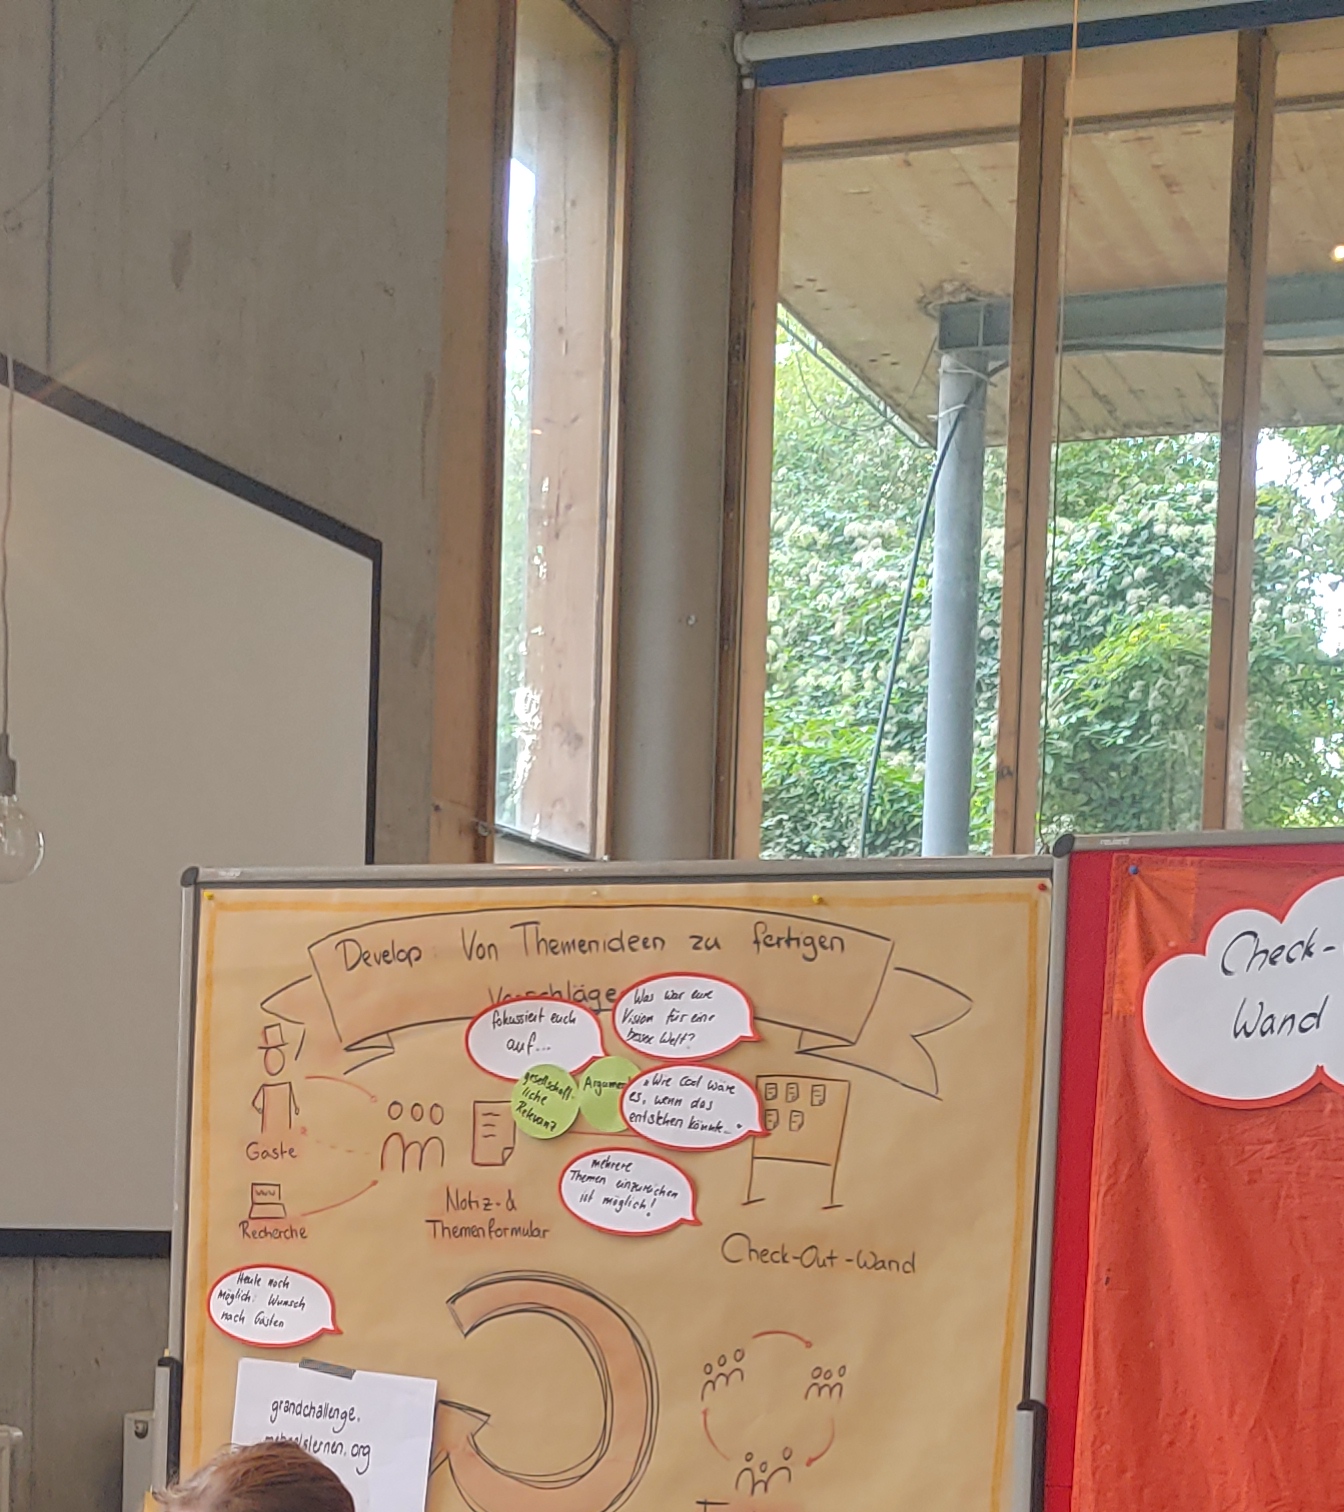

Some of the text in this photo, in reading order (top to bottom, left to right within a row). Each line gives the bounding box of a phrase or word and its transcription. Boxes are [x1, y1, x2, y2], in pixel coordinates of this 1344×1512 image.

[460, 927, 499, 962] Von
[510, 920, 666, 958] Themenideen
[689, 931, 722, 953] zu
[752, 920, 846, 962] fertigen
[634, 988, 654, 1005] Was
[549, 1010, 578, 1026] euch
[621, 1007, 654, 1025] Vision
[1232, 995, 1330, 1039] Wand
[659, 1031, 696, 1050] Welt?
[583, 1075, 632, 1096] Argume
[522, 1086, 548, 1106] liche
[654, 1095, 682, 1106] wenn
[690, 1097, 713, 1111] das
[515, 1100, 558, 1132] Relevanz
[591, 1154, 633, 1173] mehrere
[569, 1170, 607, 1185] Themen
[238, 1220, 308, 1240] Recherche
[425, 1218, 551, 1240] Themenformular
[236, 1272, 291, 1290] Heute noch
[267, 1294, 307, 1312] Wunsch
[220, 1309, 246, 1324] nach
